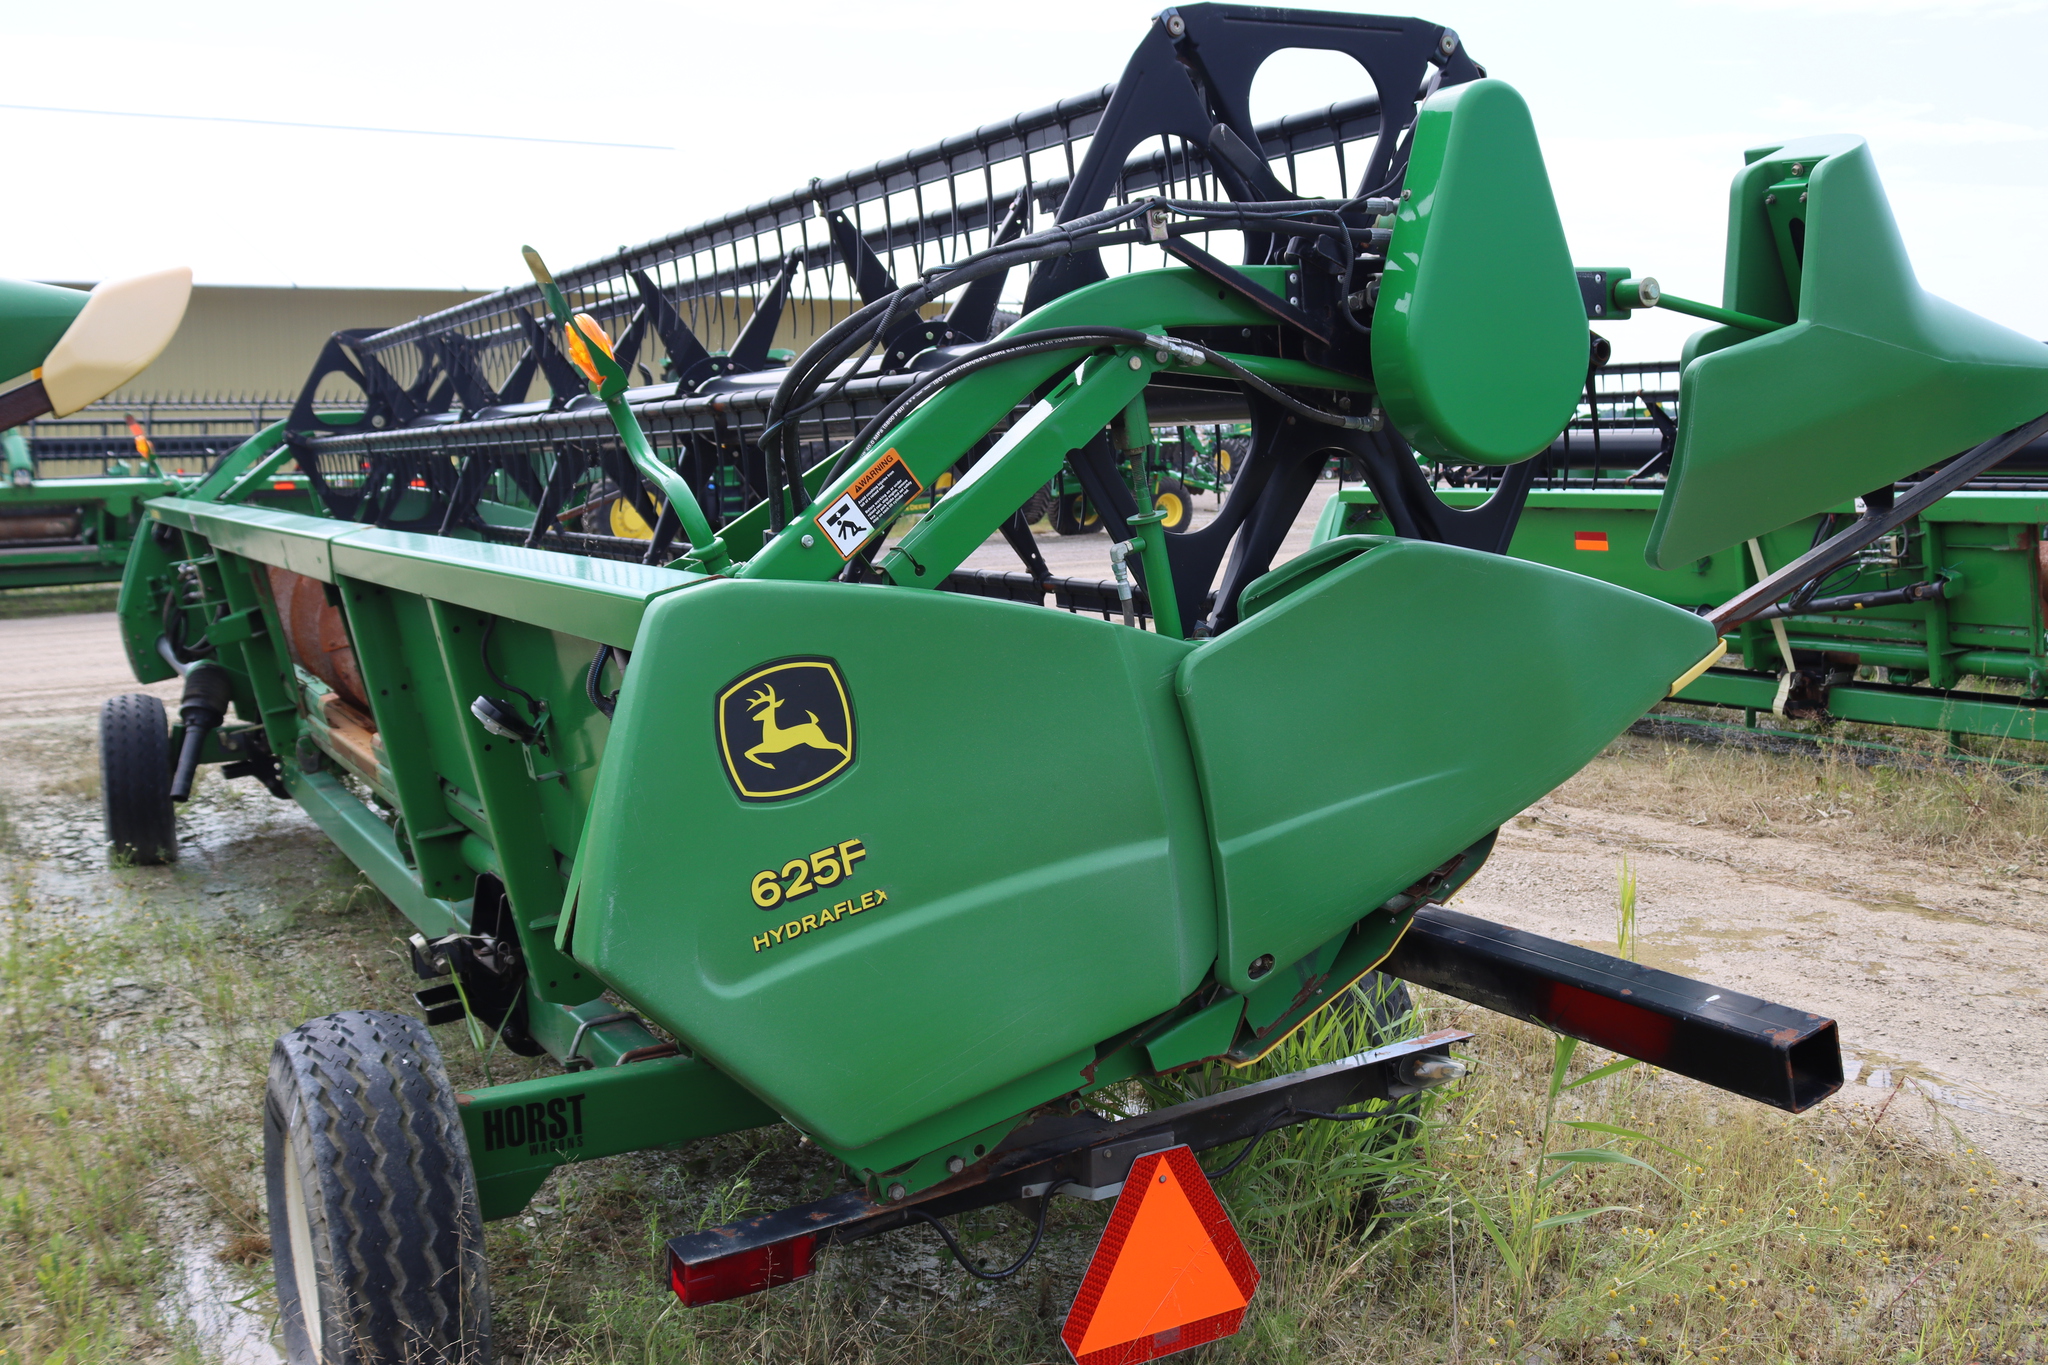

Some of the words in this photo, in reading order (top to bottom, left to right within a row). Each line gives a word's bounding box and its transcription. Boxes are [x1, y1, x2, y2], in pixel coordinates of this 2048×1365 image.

[932, 375, 944, 385] ISO
[860, 454, 894, 490] WARNING
[751, 838, 866, 911] 625F
[752, 889, 888, 953] HYDRAFLEX
[483, 1093, 586, 1152] HORST
[528, 1135, 584, 1156] WAGONS
